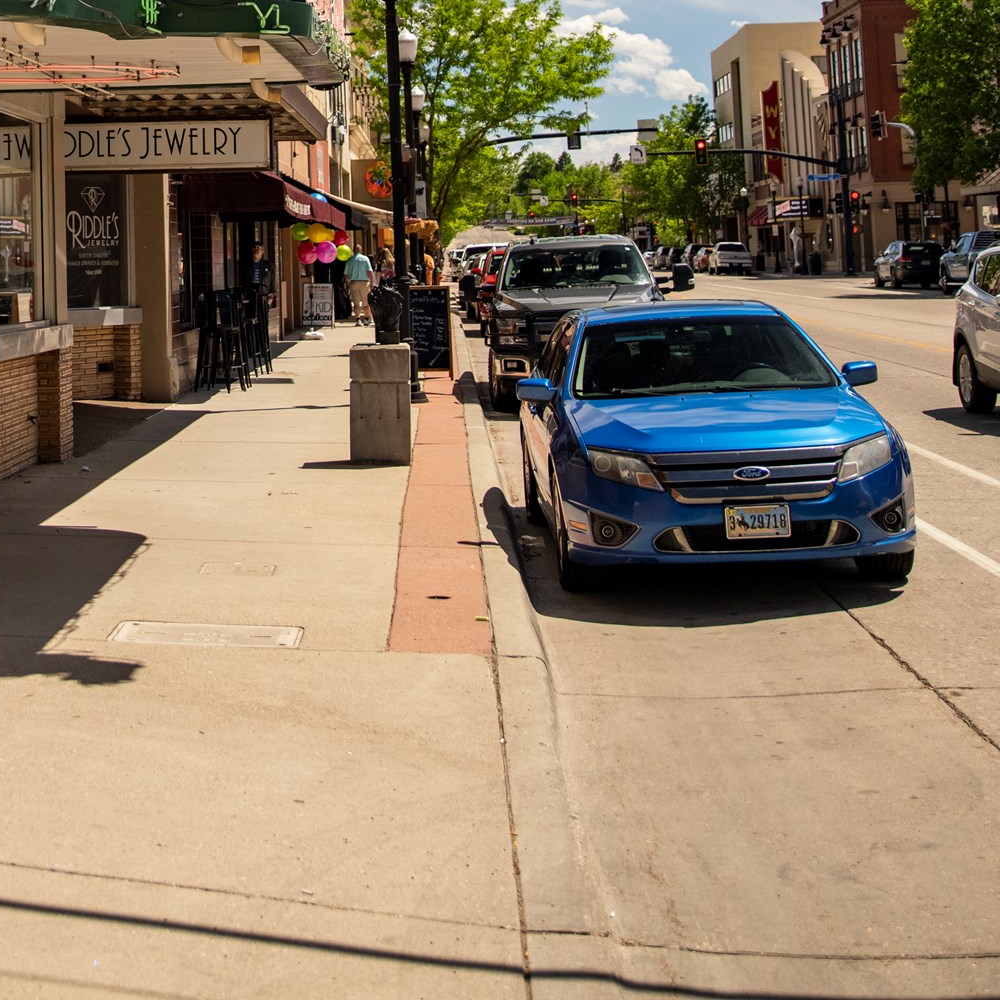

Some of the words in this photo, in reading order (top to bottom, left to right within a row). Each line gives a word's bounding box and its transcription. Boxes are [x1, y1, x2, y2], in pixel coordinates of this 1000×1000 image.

[139, 126, 242, 160] JEWELRY
[66, 210, 119, 249] RIDDLE'S
[86, 239, 120, 247] JEWELRY
[741, 468, 761, 477] Ford
[729, 515, 736, 531] 3
[750, 513, 787, 530] 29718
